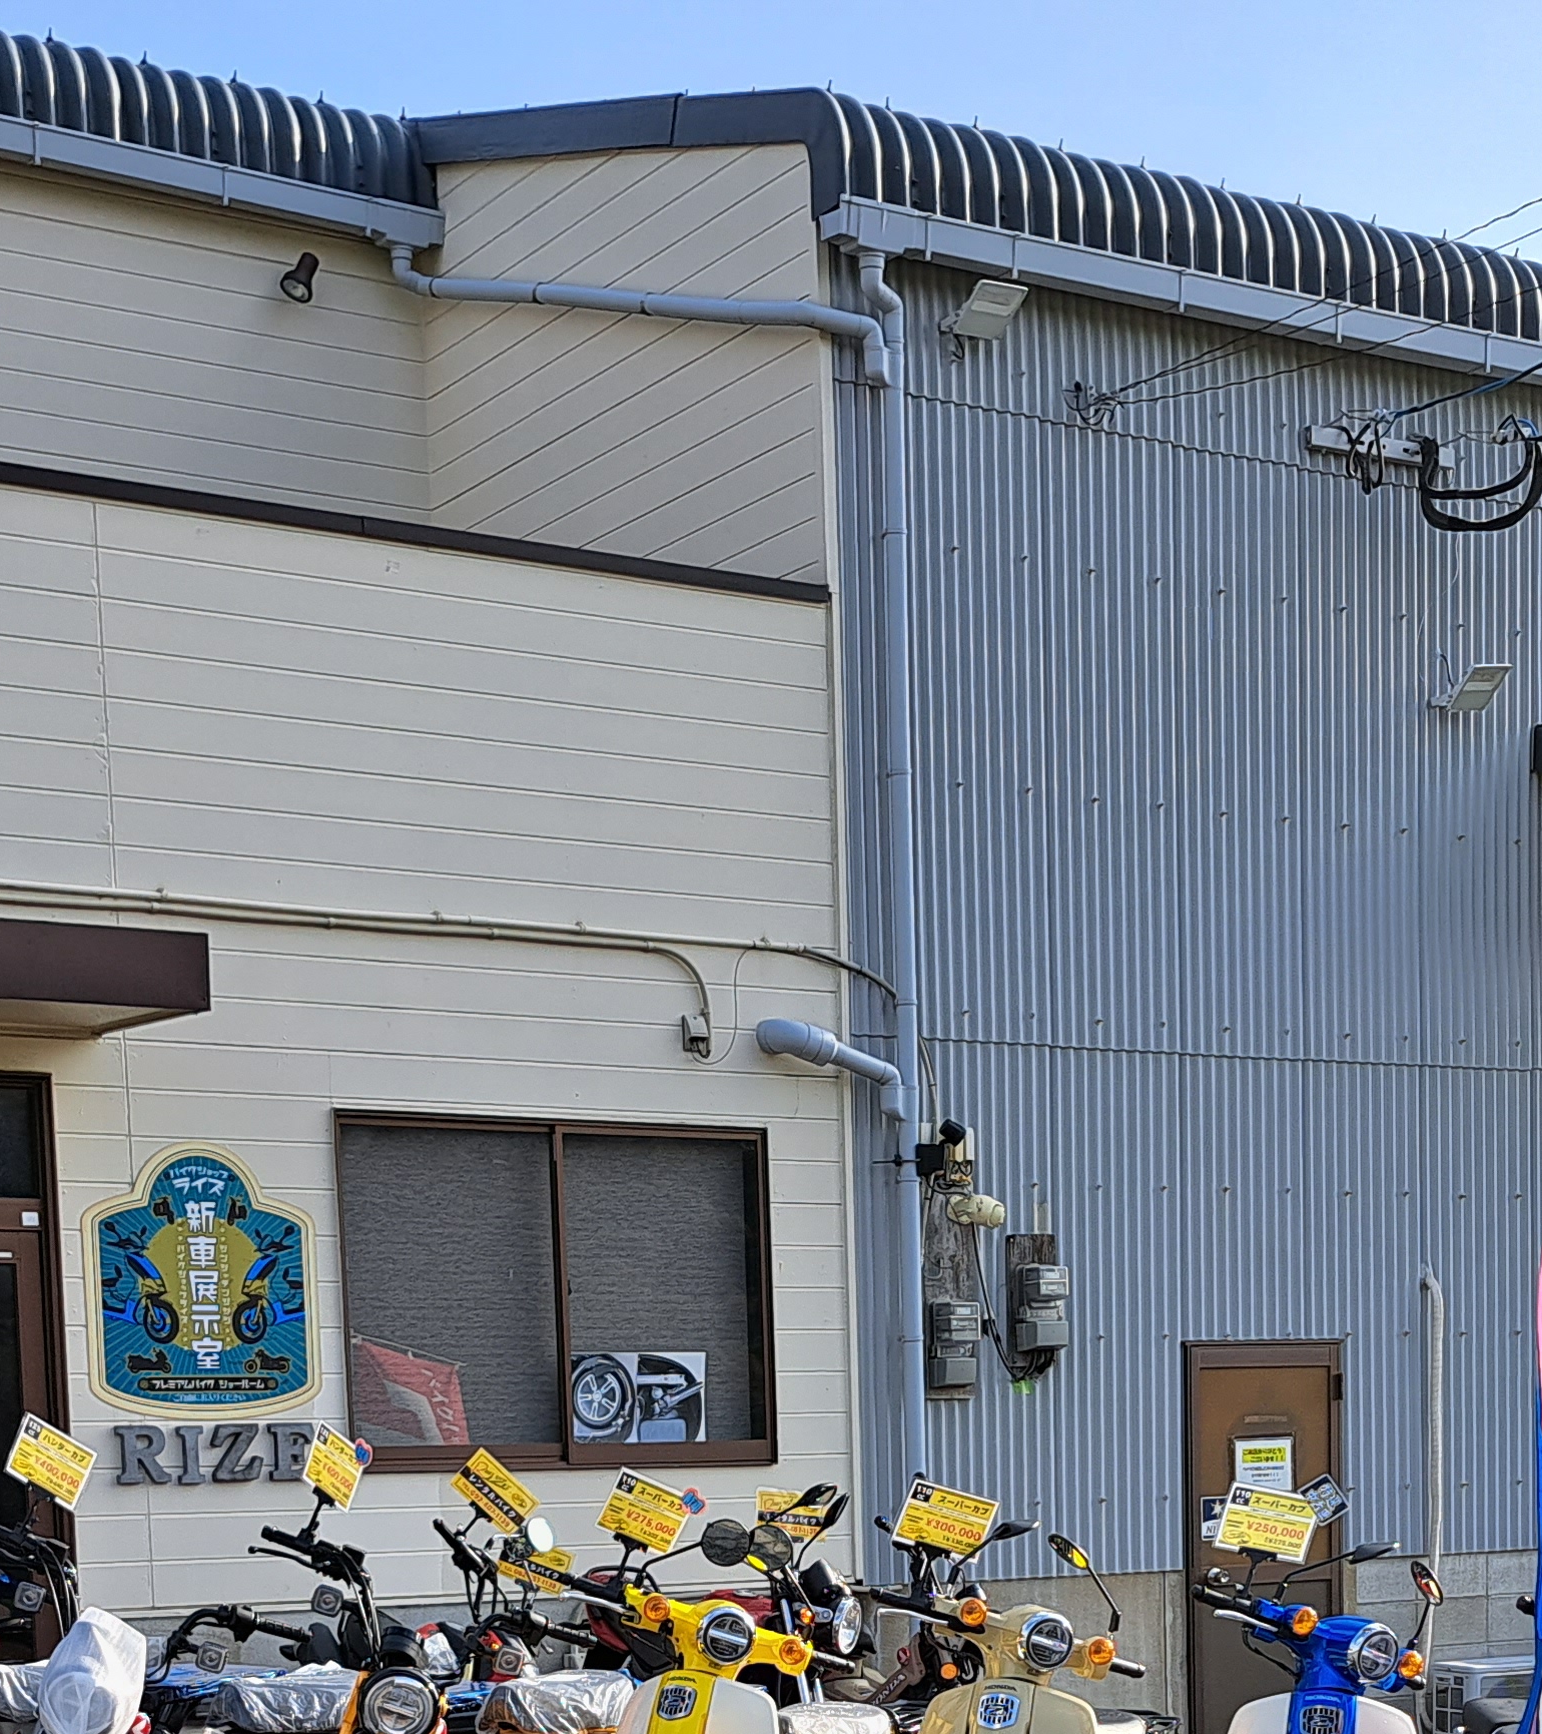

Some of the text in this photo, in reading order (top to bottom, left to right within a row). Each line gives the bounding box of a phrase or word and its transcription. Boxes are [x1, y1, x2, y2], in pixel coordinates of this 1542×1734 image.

[172, 1176, 226, 1197] ライズ
[184, 1200, 223, 1369] 新車展示室
[43, 1434, 87, 1463] ハンターカブ
[114, 1422, 315, 1487] RIZE
[469, 1474, 517, 1519] レンタルバイク
[938, 1495, 990, 1516] スーパーカブ
[1235, 1490, 1252, 1498] 110
[1252, 1496, 1308, 1514] スーパーカブ
[625, 1508, 677, 1537] ¥275,000
[926, 1517, 982, 1542] ¥300,000
[1247, 1520, 1305, 1540] ¥250,000
